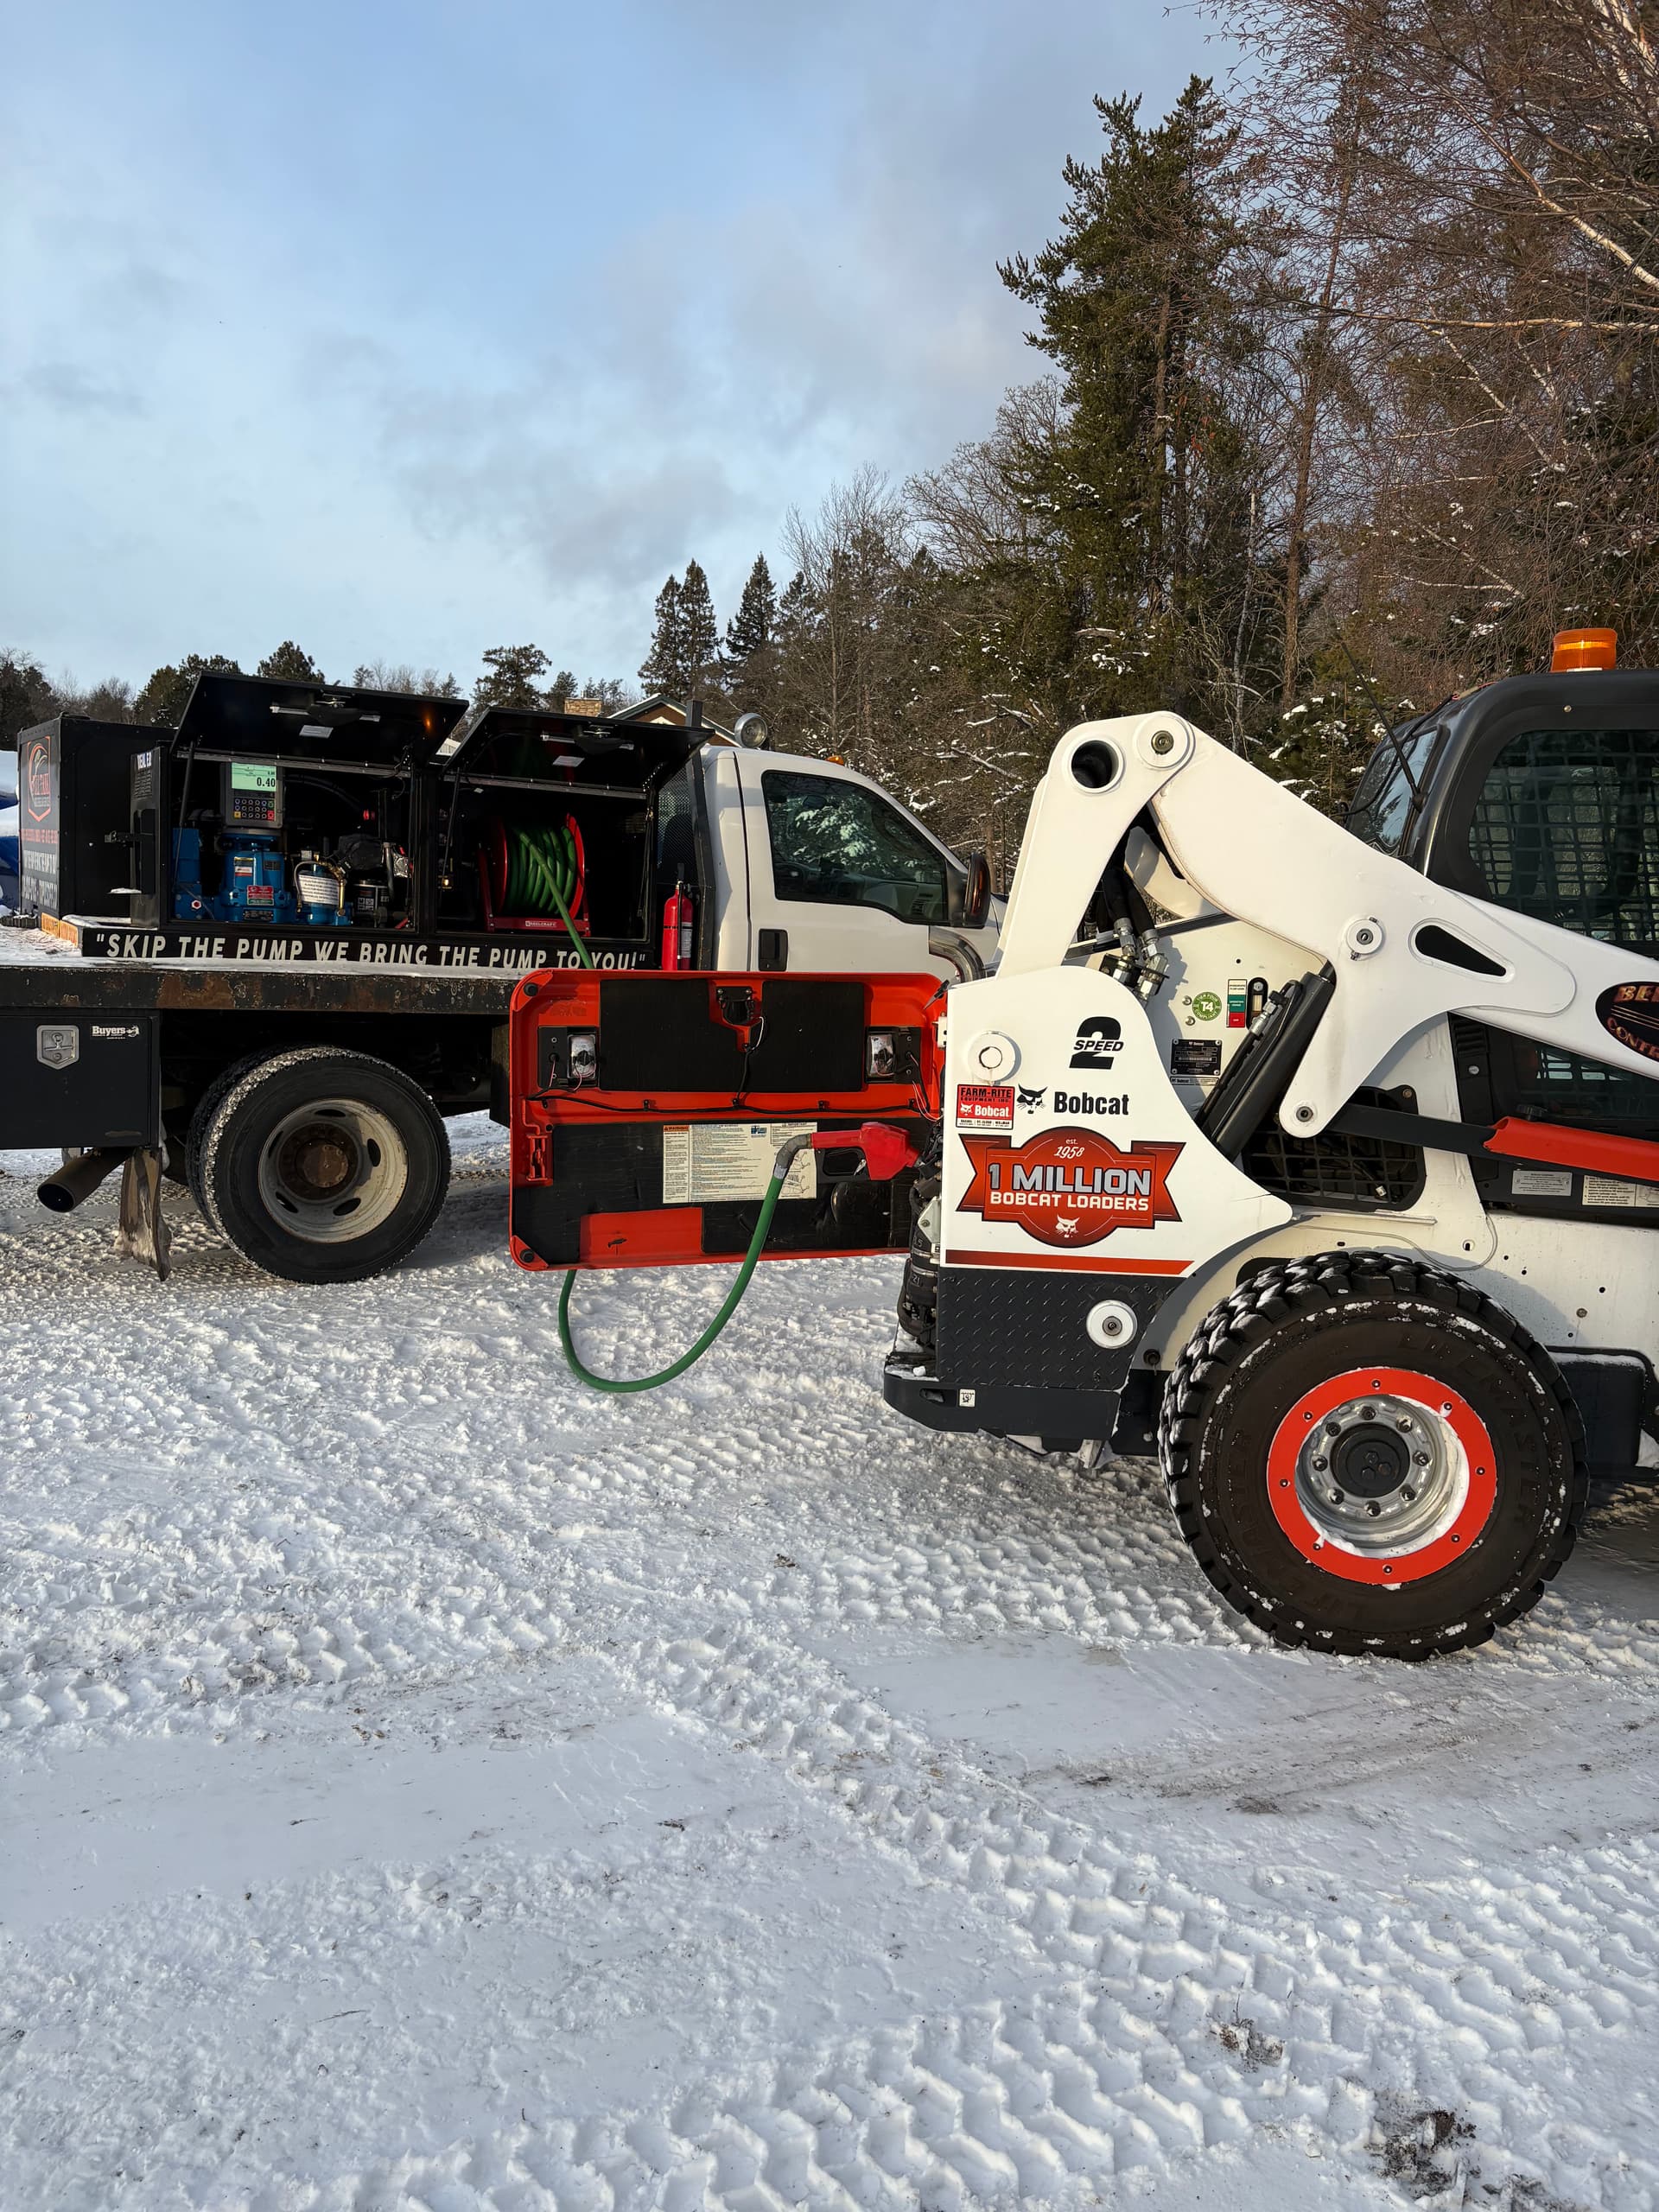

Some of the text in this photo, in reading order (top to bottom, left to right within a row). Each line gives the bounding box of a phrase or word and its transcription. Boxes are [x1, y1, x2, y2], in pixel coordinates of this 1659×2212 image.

[257, 777, 276, 787] 0.40
[96, 932, 645, 970] "SKIP THE PUMP WE BRING THE PUMP TO YOU!"
[1200, 1001, 1214, 1012] T4
[92, 1025, 126, 1037] Buyers
[1069, 1016, 1122, 1070] 2
[1073, 1039, 1124, 1052] SPEED
[960, 1087, 1012, 1098] FARM-RITE
[1053, 1091, 1129, 1116] Bobcat
[974, 1104, 1009, 1117] Bobcat
[1053, 1146, 1085, 1160] 1958
[988, 1162, 1152, 1197] 1 MILLION
[990, 1192, 1149, 1211] BOBCAT LOADERS
